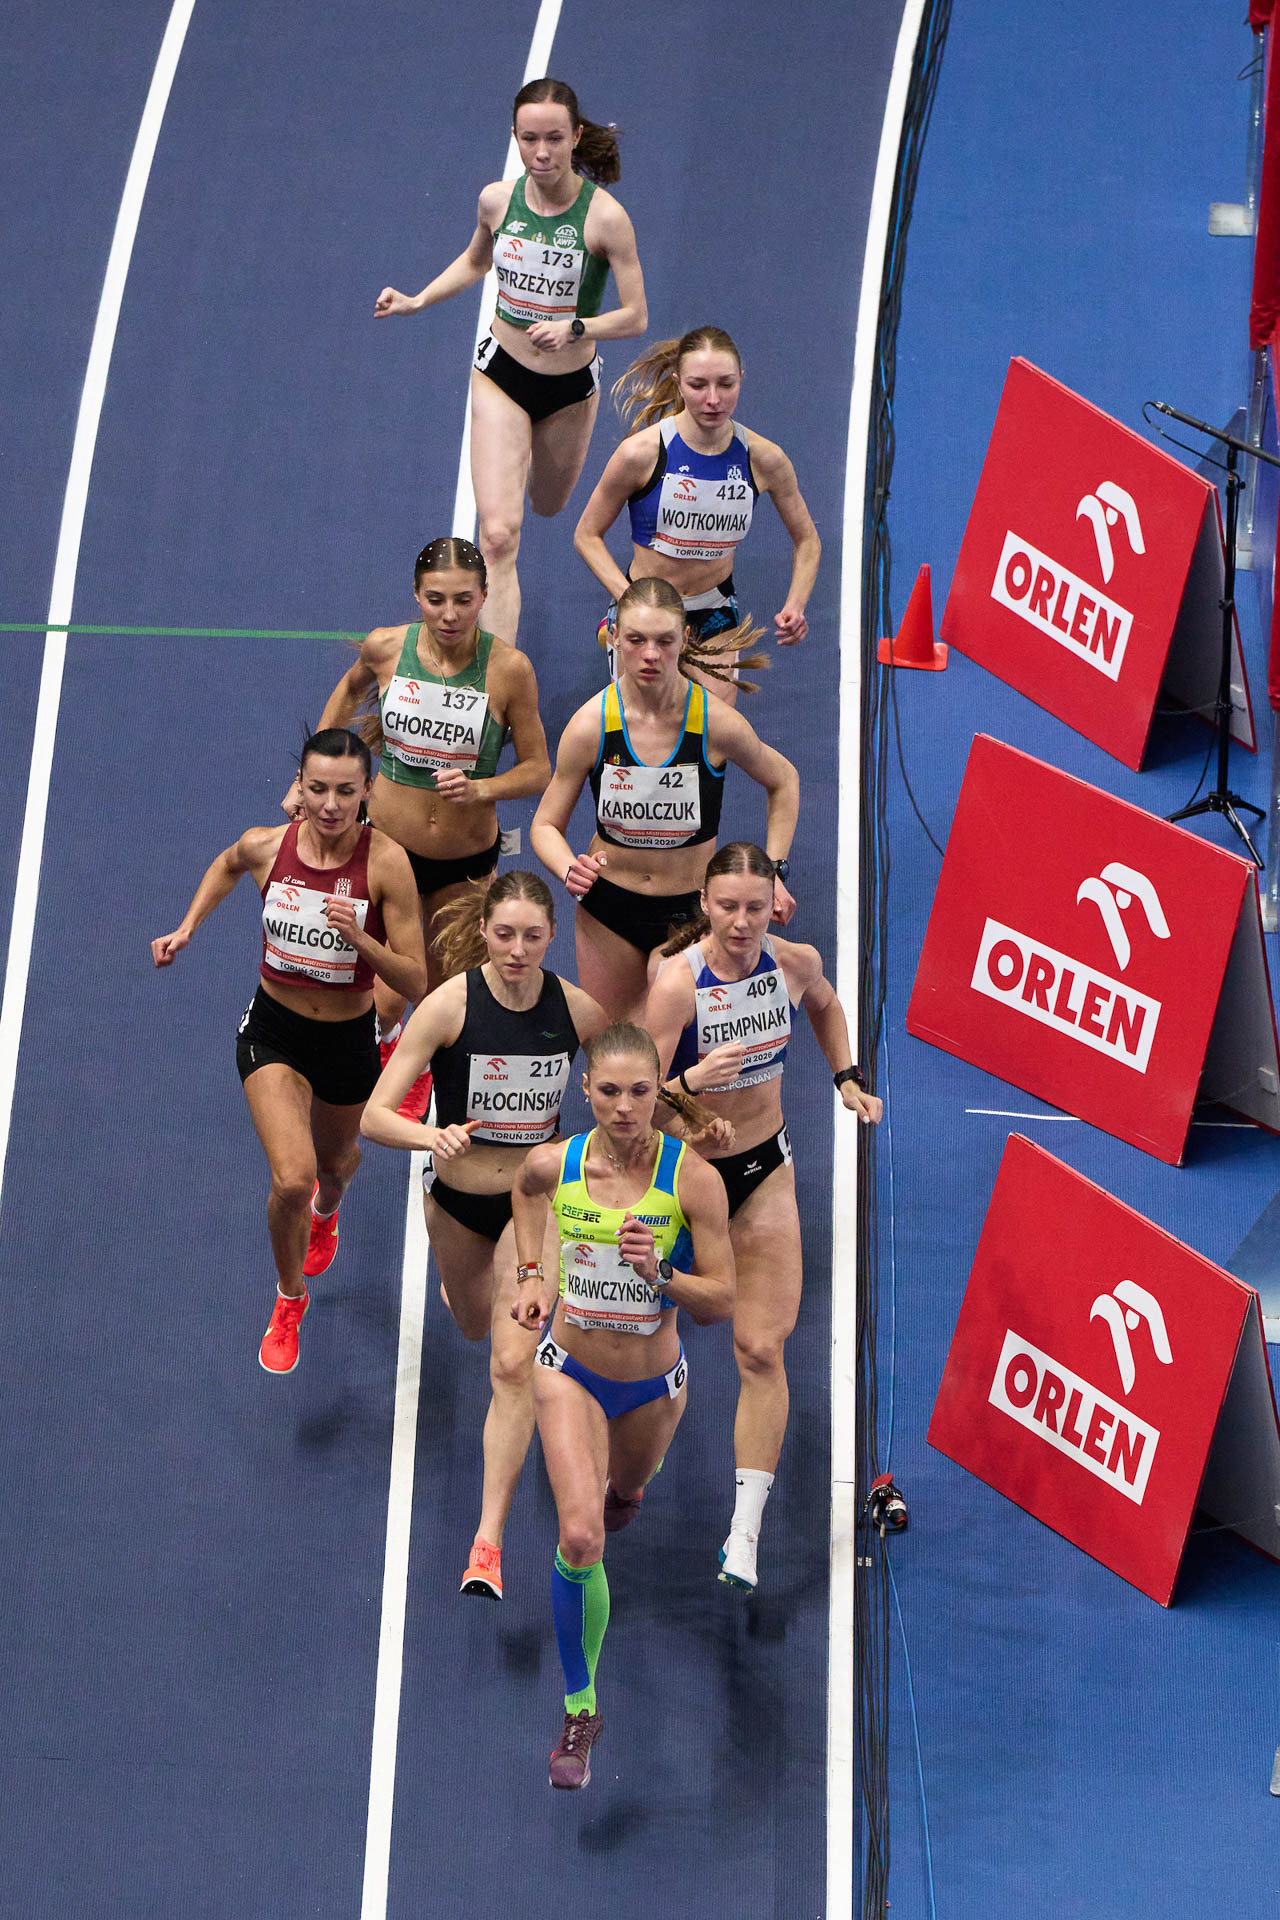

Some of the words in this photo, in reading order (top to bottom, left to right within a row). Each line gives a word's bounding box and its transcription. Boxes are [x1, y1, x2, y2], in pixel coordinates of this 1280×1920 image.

[505, 220, 528, 234] 4F
[502, 252, 524, 262] ORLEN
[541, 250, 574, 269] 173
[497, 266, 575, 297] STRZEŻYSZ
[509, 306, 533, 318] TORUŃ
[534, 312, 553, 321] 2026
[477, 336, 492, 361] 4
[673, 492, 697, 502] ORLEN
[716, 484, 747, 501] 412
[662, 507, 748, 532] WOJTKOWIAK
[1004, 550, 1123, 666] ORLEN
[398, 695, 420, 705] ORLEN
[442, 691, 479, 712] 137
[385, 711, 476, 746] CHORZĘPA
[400, 753, 429, 765] TORUŃ
[430, 759, 452, 769] 2026
[609, 783, 634, 791] ORLEN
[658, 771, 684, 789] 42
[602, 799, 696, 821] KAROLCZUK
[623, 837, 653, 845] TORUŃ
[276, 901, 300, 913] ORLEN
[309, 969, 331, 979] 2026
[746, 976, 778, 998] 409
[987, 939, 1147, 1056] ORLEN
[708, 1003, 732, 1013] ORLEN
[702, 1006, 787, 1044] STEMPNIAK
[753, 1051, 773, 1062] 2026
[529, 1058, 563, 1078] 217
[471, 1088, 562, 1112] PŁOCIŃSKA
[491, 1131, 523, 1140] TORUŃ
[574, 1257, 596, 1268] ORLEN
[568, 1273, 660, 1304] KRAWCZYŃSKA
[583, 1320, 615, 1329] TORUŃ
[616, 1323, 640, 1331] 2026
[540, 1343, 557, 1367] 6
[674, 1362, 685, 1389] 6
[1005, 1353, 1147, 1486] ORLEN
